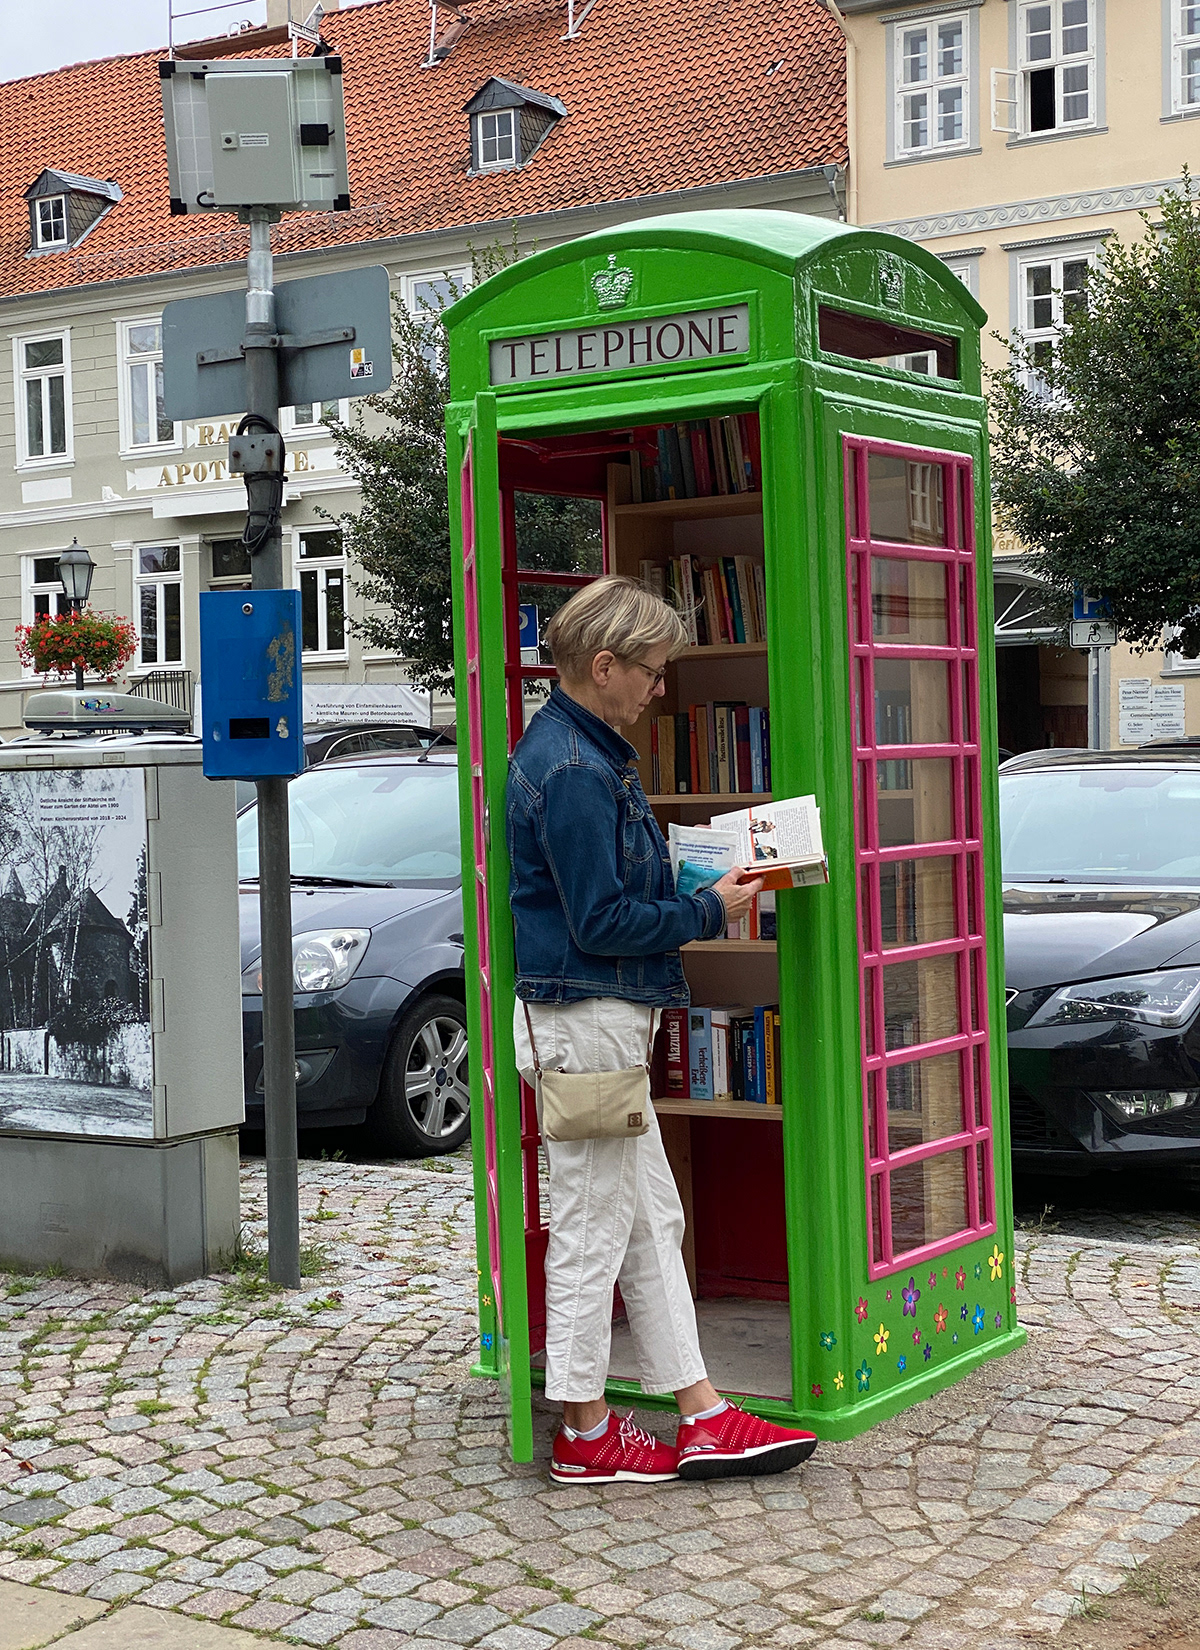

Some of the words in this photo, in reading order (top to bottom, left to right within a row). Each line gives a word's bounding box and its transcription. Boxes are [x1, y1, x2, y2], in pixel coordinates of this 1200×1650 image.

[502, 314, 738, 378] TELEPHONE
[157, 450, 316, 487] APOTE.
[667, 1021, 680, 1063] Mazurka
[691, 1068, 700, 1085] Erde
[698, 1047, 708, 1086] Verheißene
